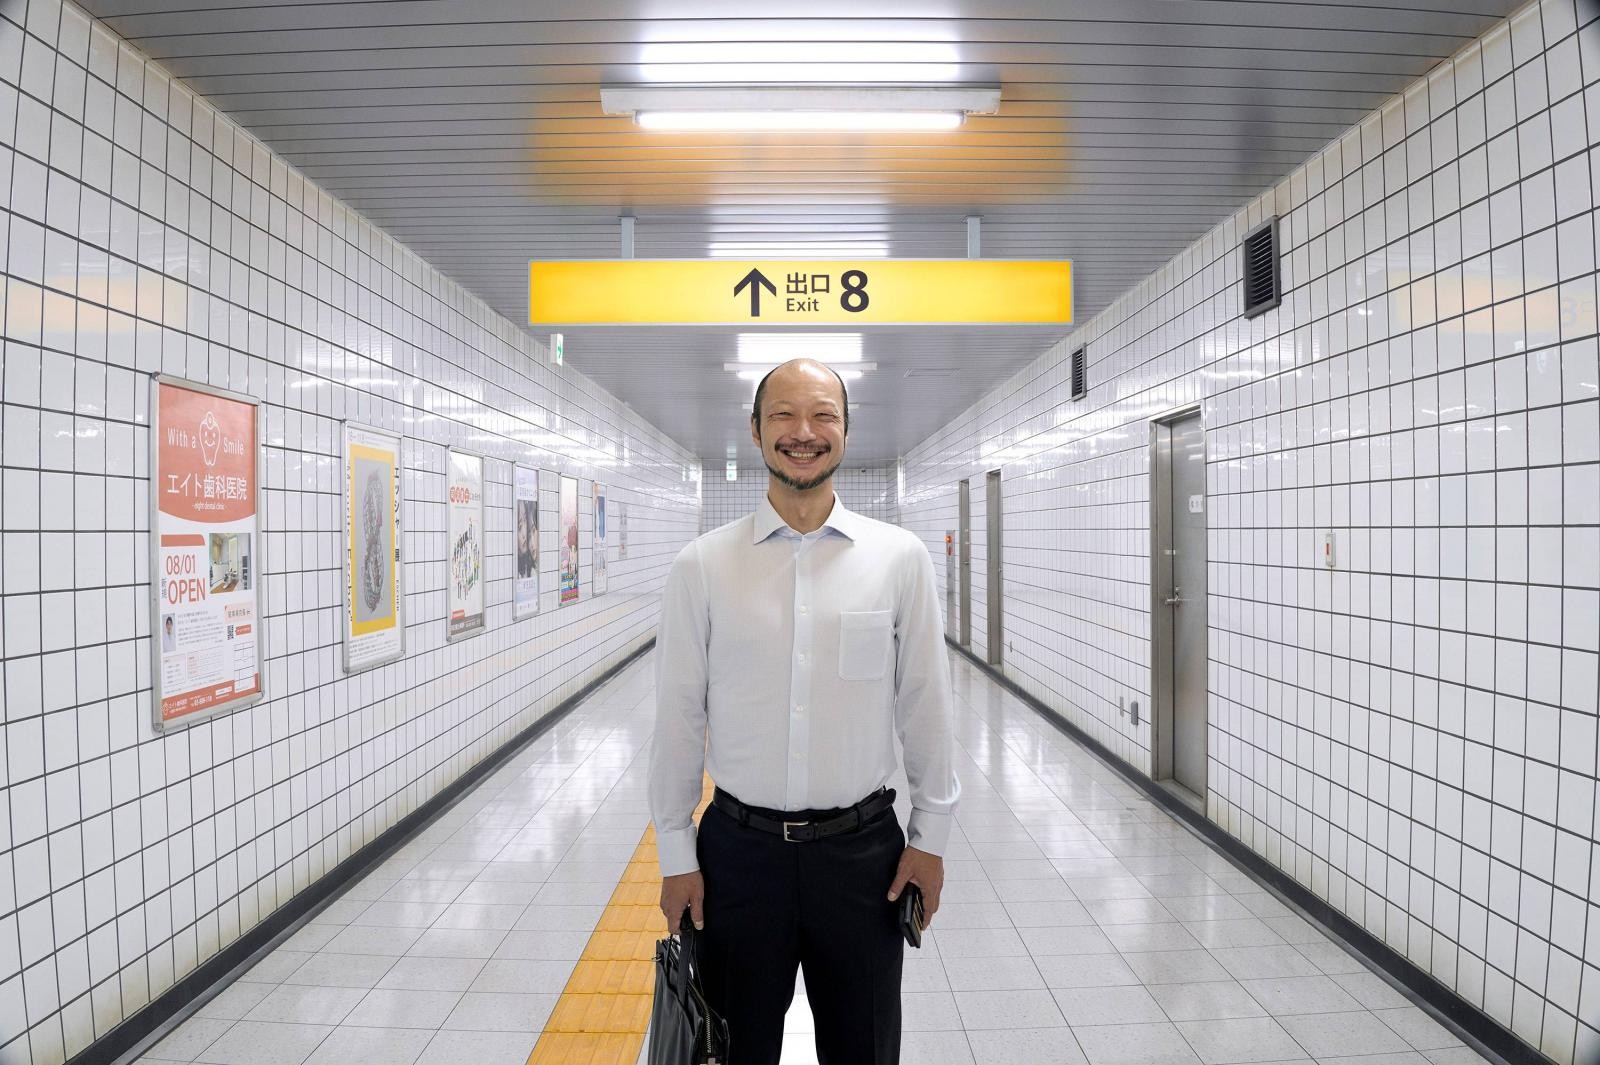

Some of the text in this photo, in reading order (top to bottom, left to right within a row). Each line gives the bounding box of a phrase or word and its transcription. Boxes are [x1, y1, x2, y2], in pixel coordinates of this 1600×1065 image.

[786, 271, 830, 295] 出口
[840, 269, 870, 313] 8
[786, 297, 820, 312] Exit
[167, 427, 244, 456] With a Smile
[167, 473, 248, 501] エイト歯科医院
[166, 554, 196, 576] 08/01
[168, 578, 206, 605] OPEN
